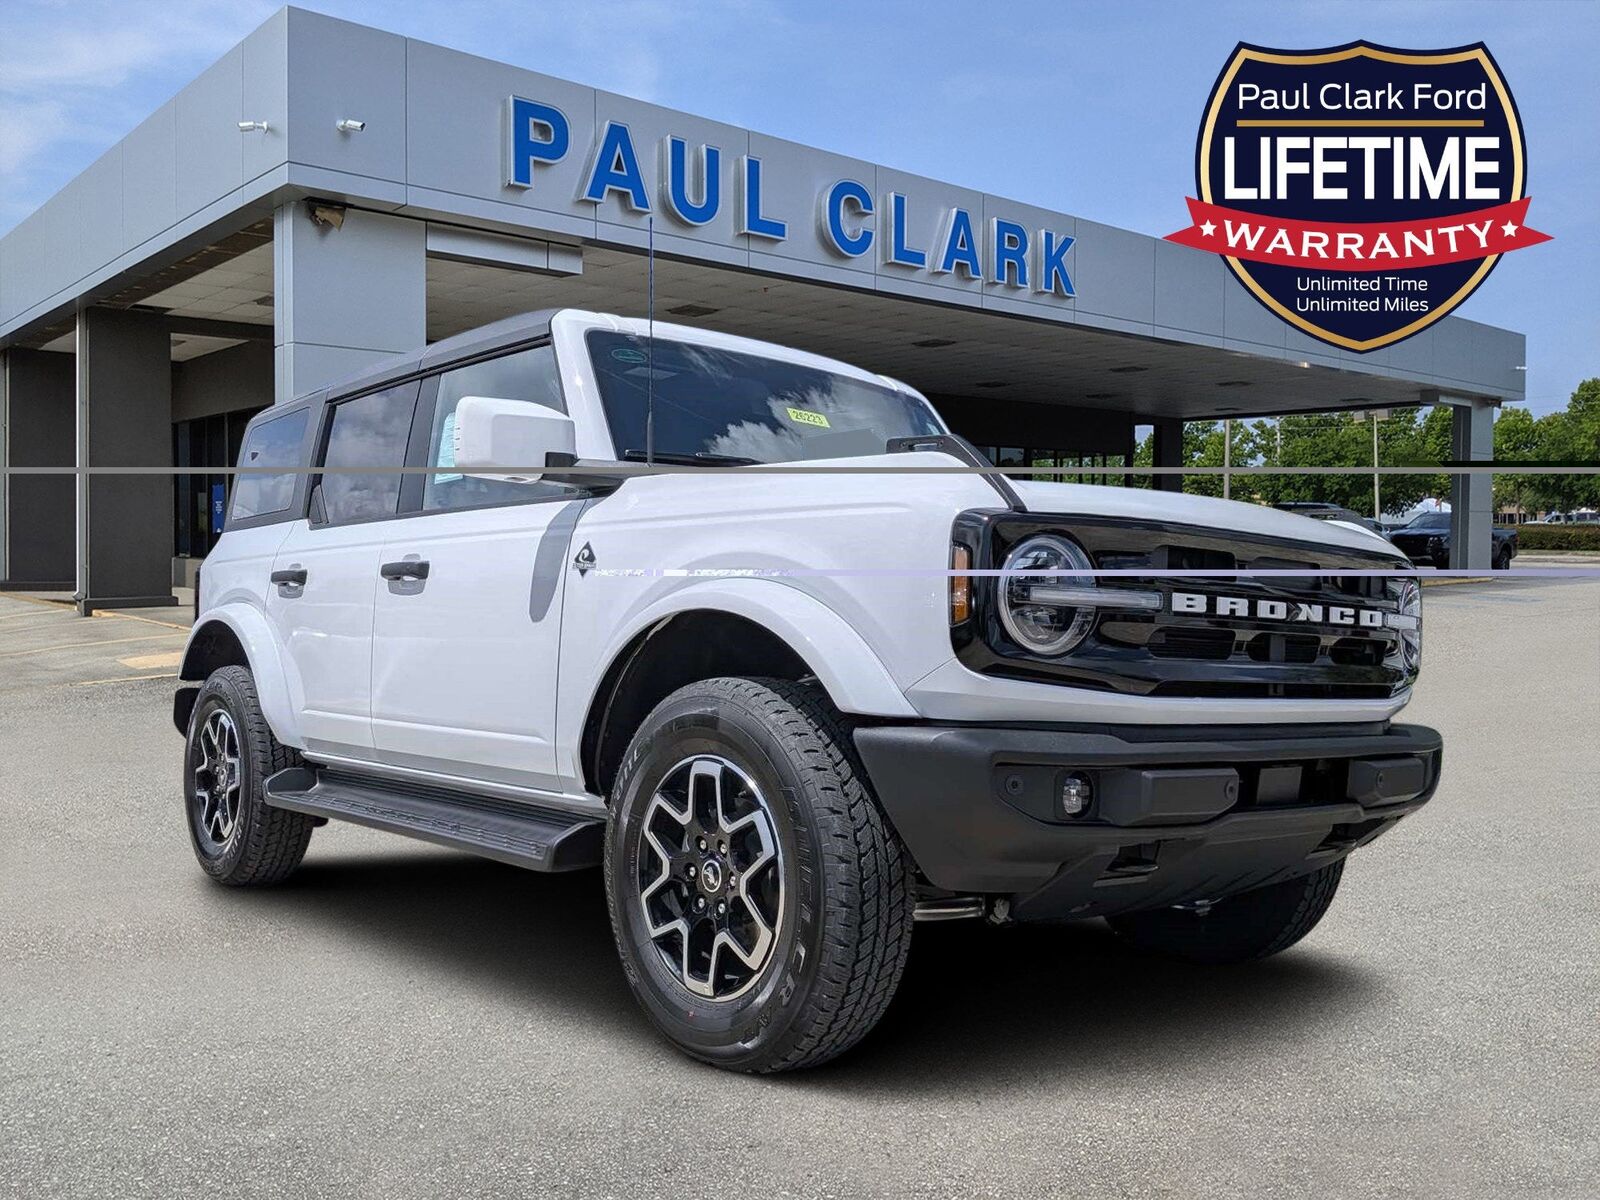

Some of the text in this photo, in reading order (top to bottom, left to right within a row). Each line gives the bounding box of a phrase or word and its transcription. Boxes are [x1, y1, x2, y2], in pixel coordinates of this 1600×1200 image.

[506, 94, 1077, 297] PAUL CLARK
[1171, 592, 1383, 628] BRONCO
